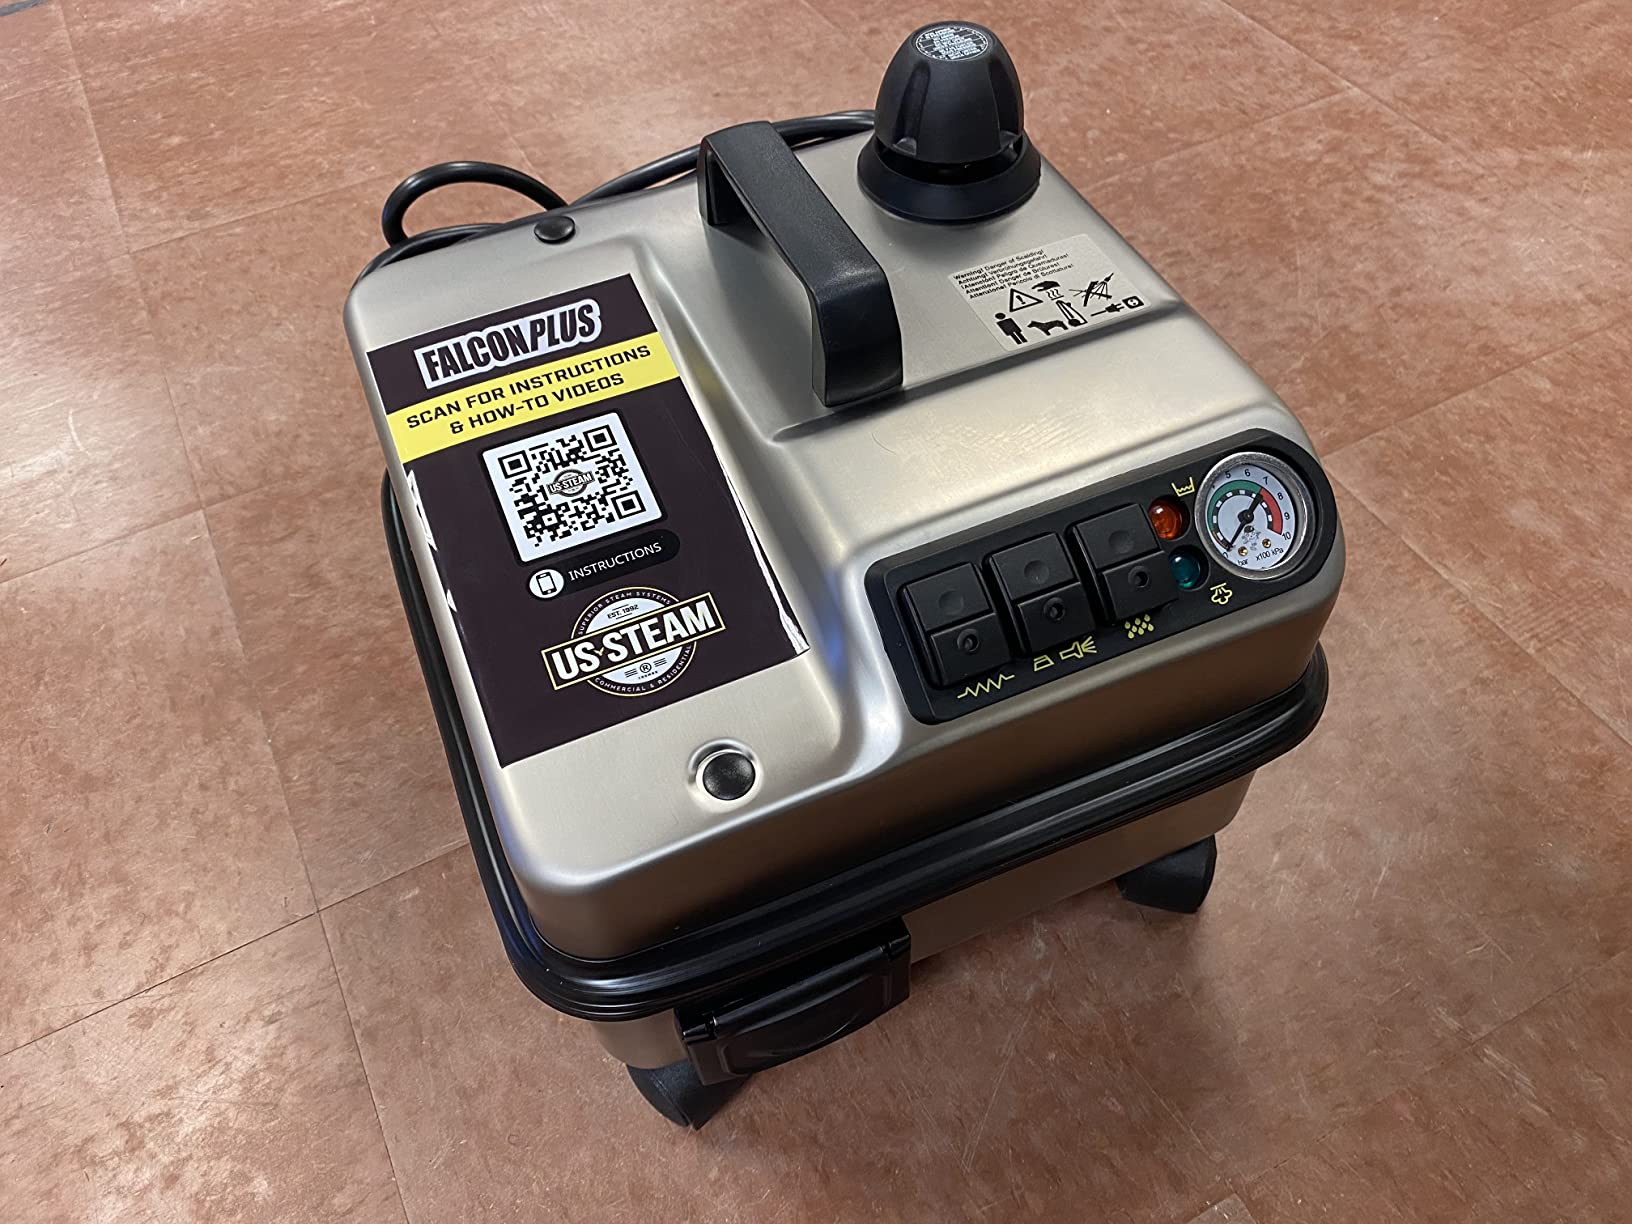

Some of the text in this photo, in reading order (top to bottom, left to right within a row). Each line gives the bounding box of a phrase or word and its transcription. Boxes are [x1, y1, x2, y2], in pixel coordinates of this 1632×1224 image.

[984, 260, 1007, 271] Danger
[958, 272, 988, 285] Achtung!
[966, 280, 998, 295] Attention!
[998, 273, 1021, 284] Danger
[421, 303, 596, 382] FALCON PLUS
[406, 345, 651, 429] SCAN FOR INSTRUCTIONS
[449, 372, 625, 435] & HOW-TO VIDEOS
[549, 472, 593, 493] US STEAM
[1245, 469, 1251, 477] 6
[1263, 477, 1268, 485] 7
[1284, 512, 1290, 520] 9
[1282, 531, 1291, 540] 10
[568, 542, 662, 582] INSTRUCTIONS
[1255, 547, 1284, 561] x100 kPa
[578, 591, 671, 635] SUPERIOR STEAM SYSTEMS
[607, 604, 640, 620] EST. 1992
[550, 600, 717, 681] US STEAM
[594, 677, 646, 693] COMMERCIAL
[657, 645, 693, 685] RESIDENTIAL
